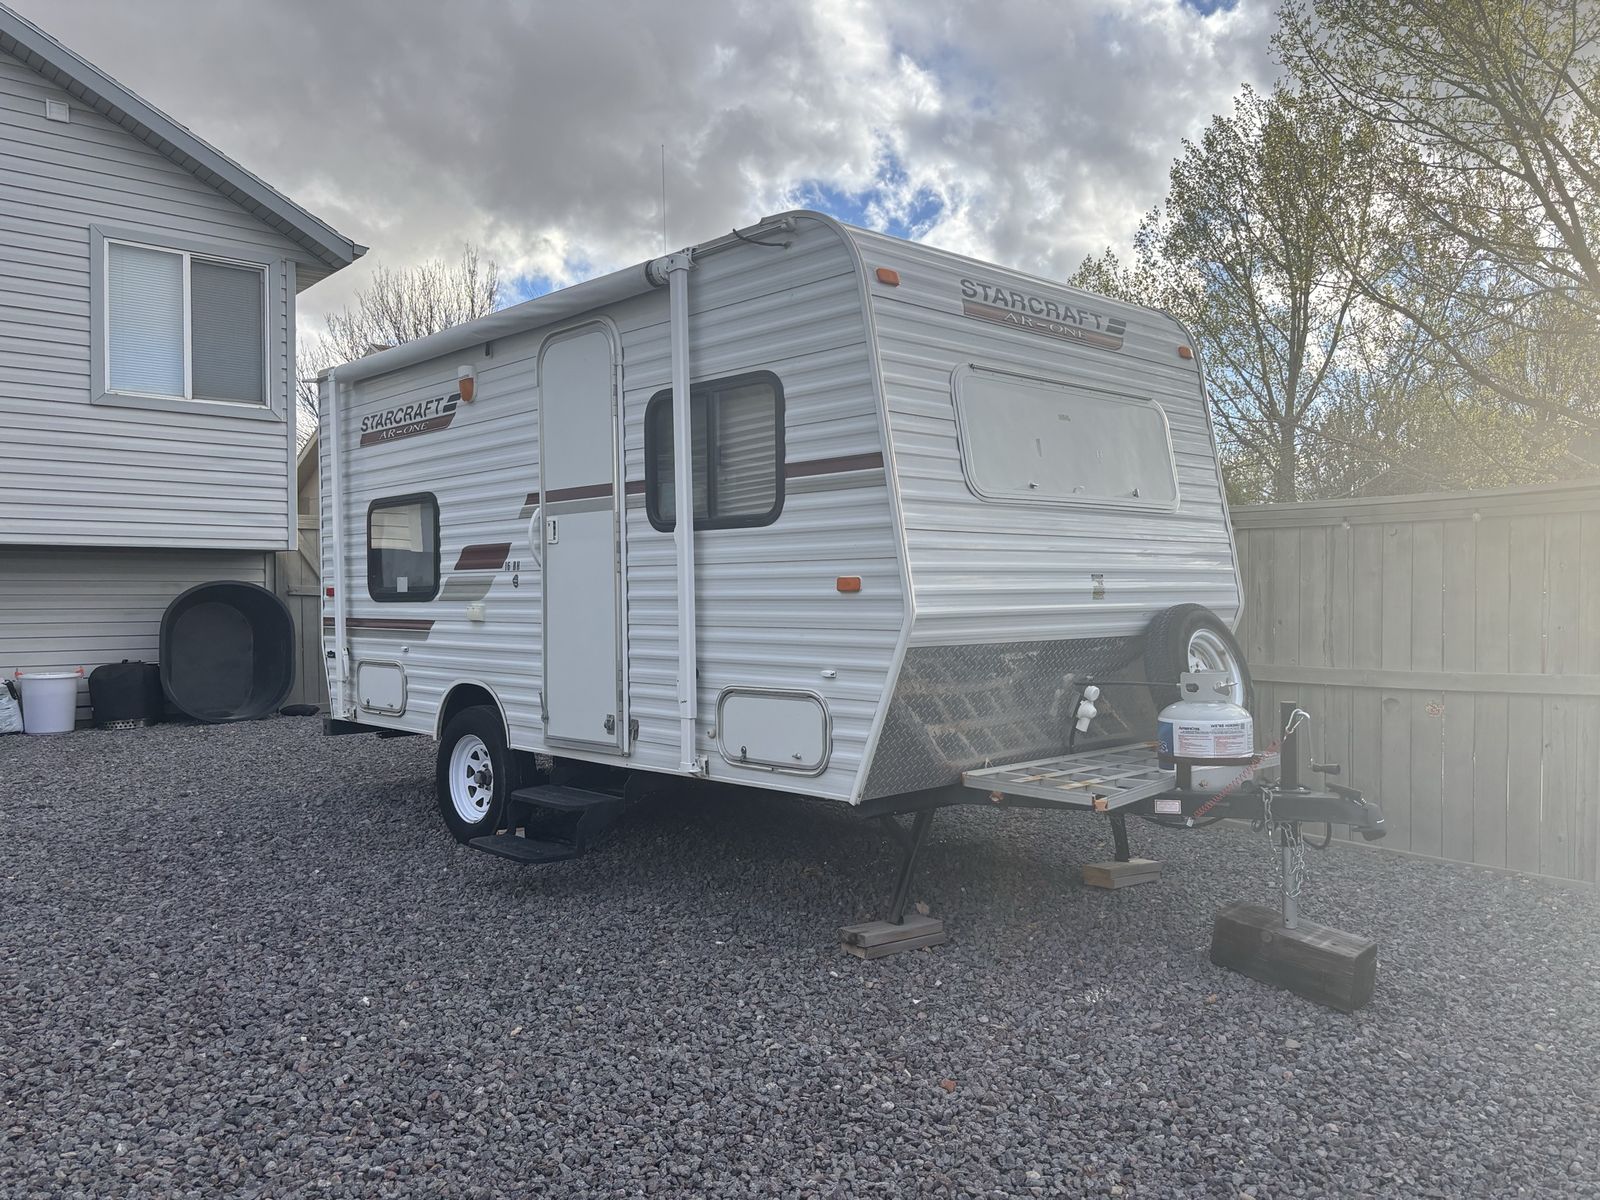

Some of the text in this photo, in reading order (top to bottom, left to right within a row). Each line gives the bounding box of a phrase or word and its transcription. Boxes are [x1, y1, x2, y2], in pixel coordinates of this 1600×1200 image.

[960, 278, 1102, 330] STARCRAFT
[1004, 312, 1088, 338] AR-ONE
[360, 397, 444, 433] STARCRAFT
[379, 421, 429, 440] AR-ONE
